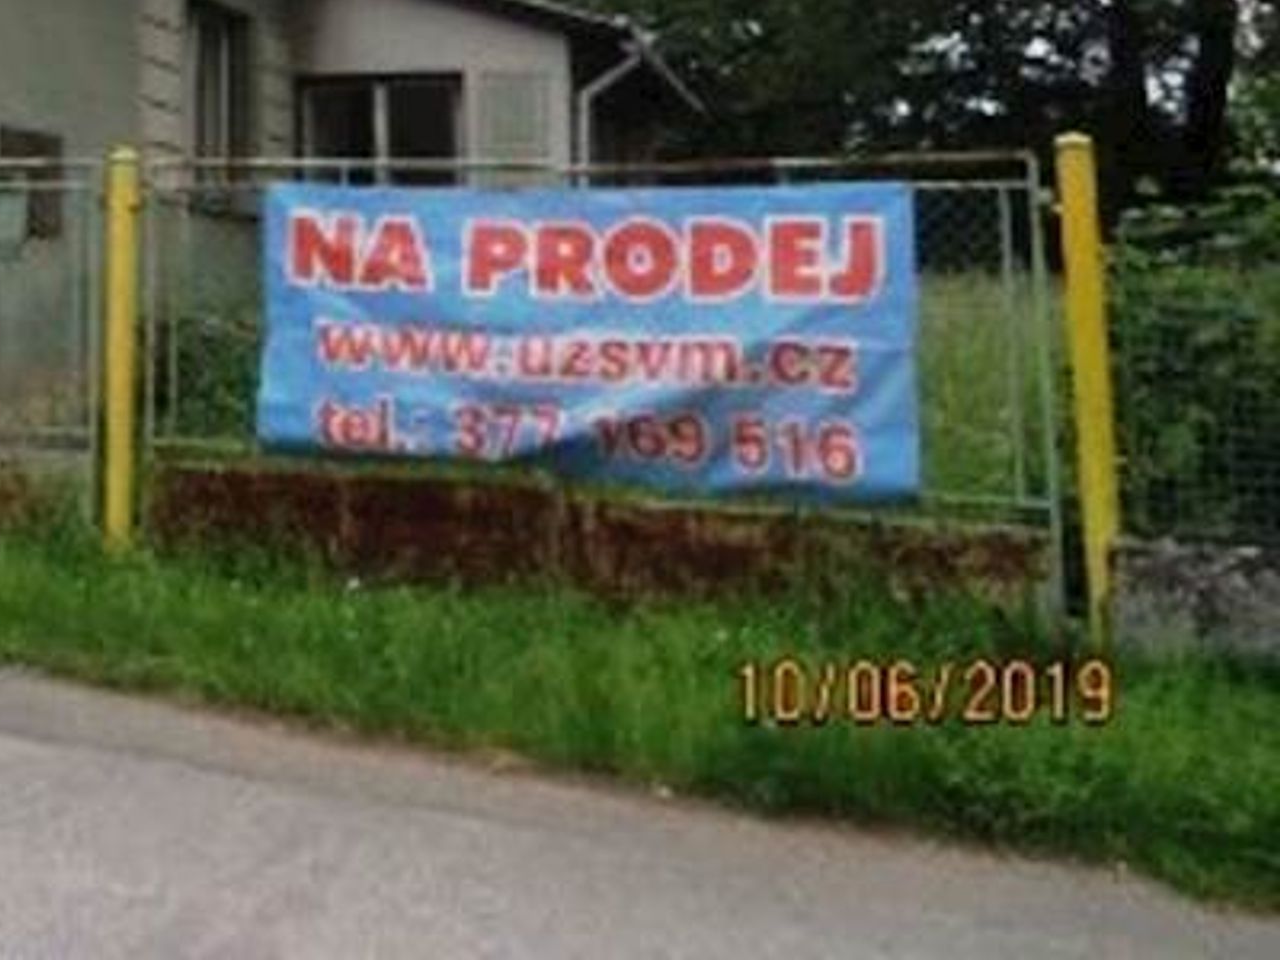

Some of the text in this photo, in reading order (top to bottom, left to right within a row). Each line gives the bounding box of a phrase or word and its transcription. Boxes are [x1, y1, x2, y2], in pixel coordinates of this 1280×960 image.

[287, 212, 883, 300] NA PRODEJ
[317, 322, 858, 390] www.uzsvm.cz
[454, 402, 562, 457] 377
[596, 413, 706, 466] 169
[733, 415, 860, 482] 516
